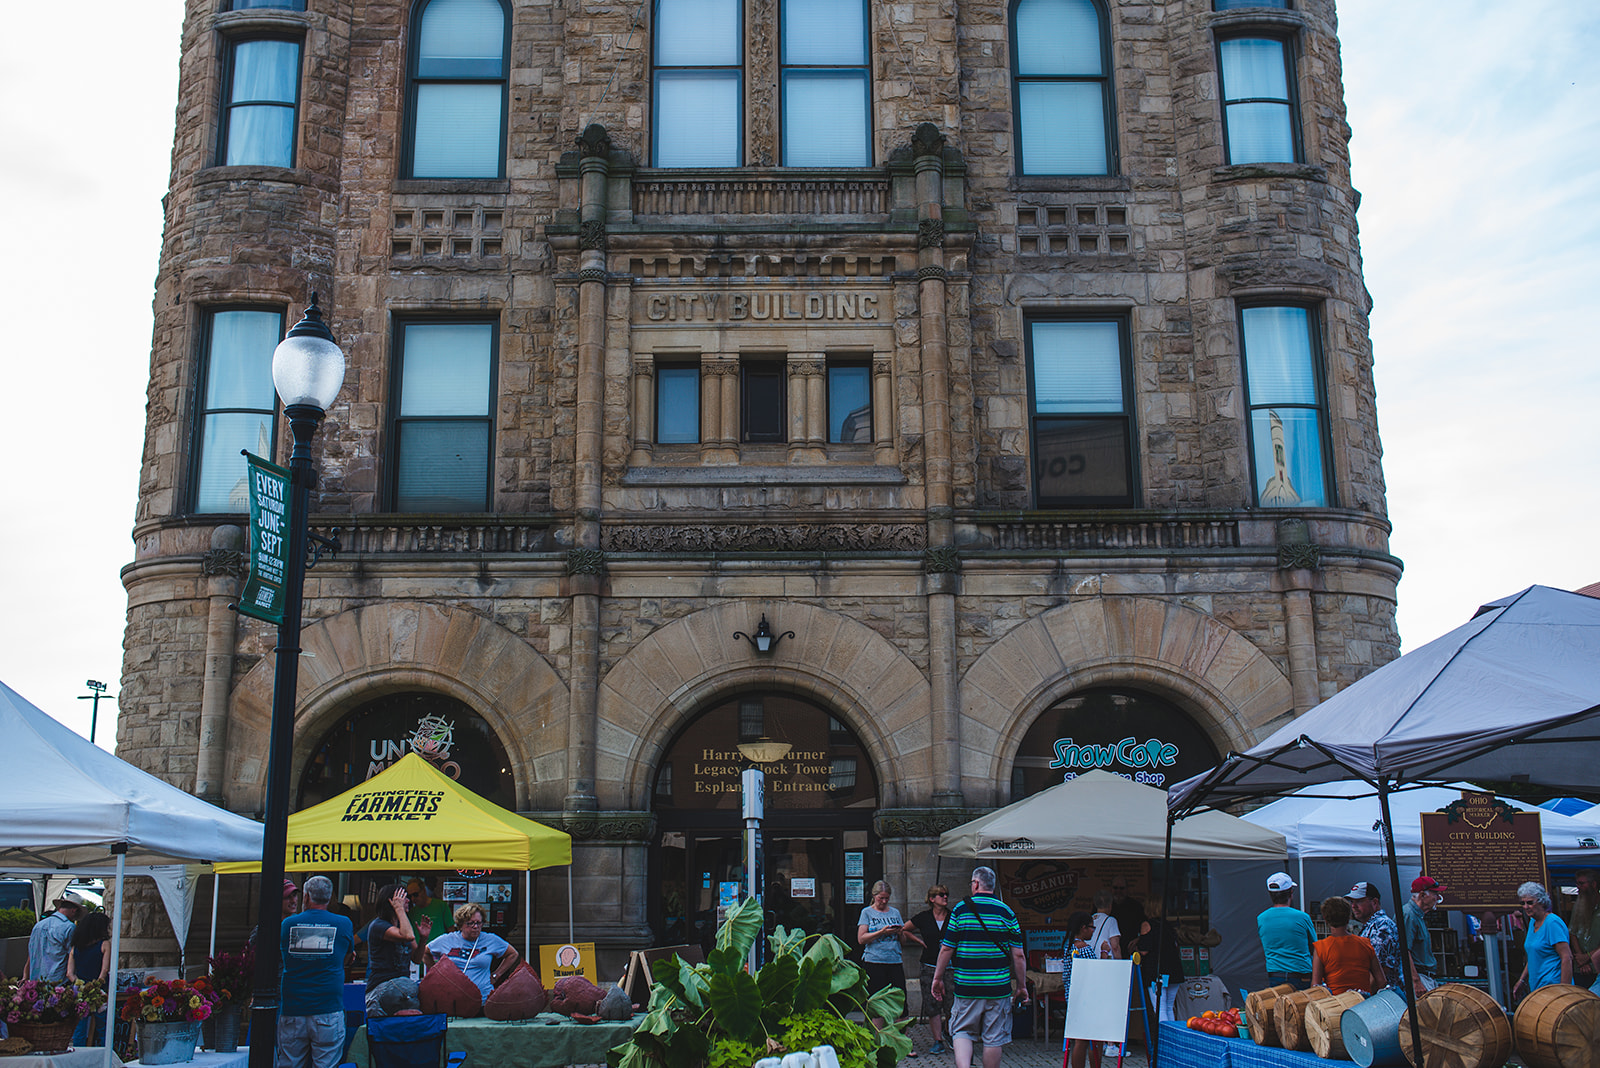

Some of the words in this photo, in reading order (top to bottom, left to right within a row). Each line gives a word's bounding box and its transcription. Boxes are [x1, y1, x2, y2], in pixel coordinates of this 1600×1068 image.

[647, 292, 720, 321] CITY
[728, 291, 878, 320] BUILDING
[256, 472, 284, 501] EVERY
[257, 493, 285, 516] SATURDAY
[260, 530, 283, 557] SEPT
[702, 749, 744, 762] Harry
[752, 749, 771, 760] M.
[1049, 737, 1116, 769] Snow
[694, 763, 742, 777] Legacy
[793, 763, 834, 775] Tower
[1135, 771, 1165, 787] Shop
[354, 789, 445, 798] SPRINGFIELD
[695, 781, 766, 795] Esplan
[773, 780, 837, 792] Entrance
[345, 795, 442, 814] FARMERS
[1469, 797, 1488, 805] OHIO
[341, 813, 437, 822] MARKET
[1449, 832, 1471, 840] CITY
[1474, 831, 1515, 840] BUILDING
[1024, 873, 1075, 896] PEANUT
